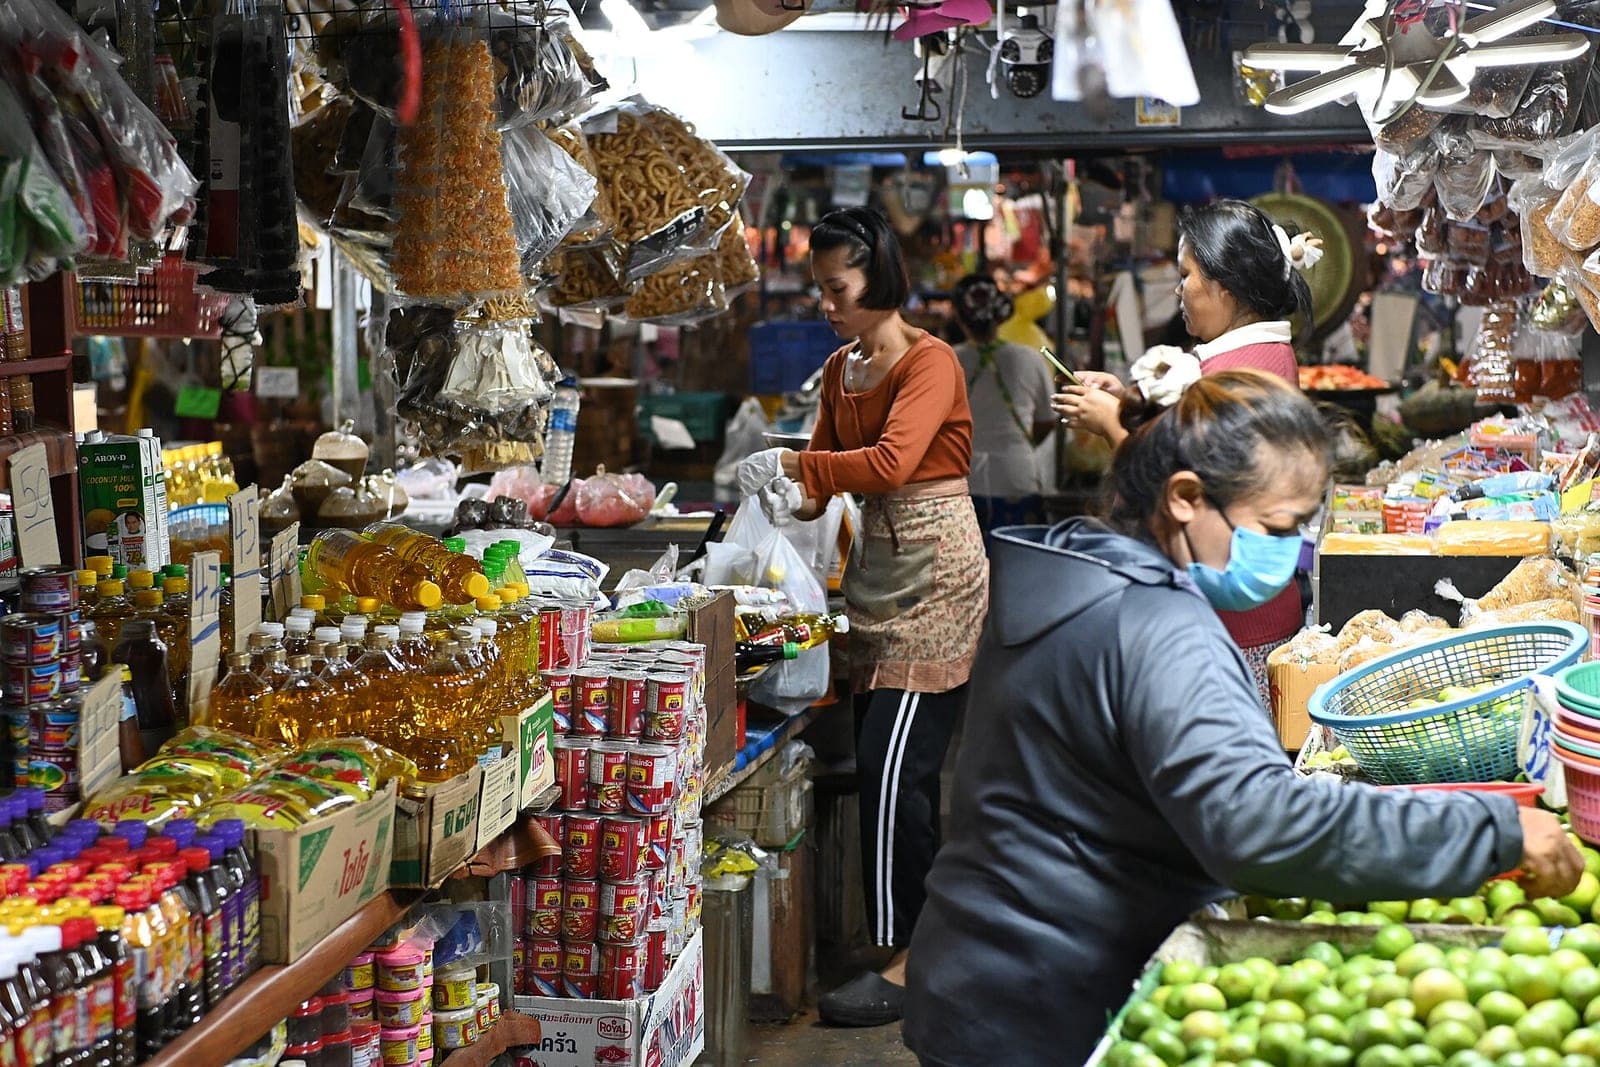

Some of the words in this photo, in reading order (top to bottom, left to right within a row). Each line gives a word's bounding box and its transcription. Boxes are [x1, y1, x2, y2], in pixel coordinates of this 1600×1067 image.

[86, 476, 119, 484] COCONUT
[20, 465, 51, 519] 50
[599, 1021, 629, 1034] ROYAL
